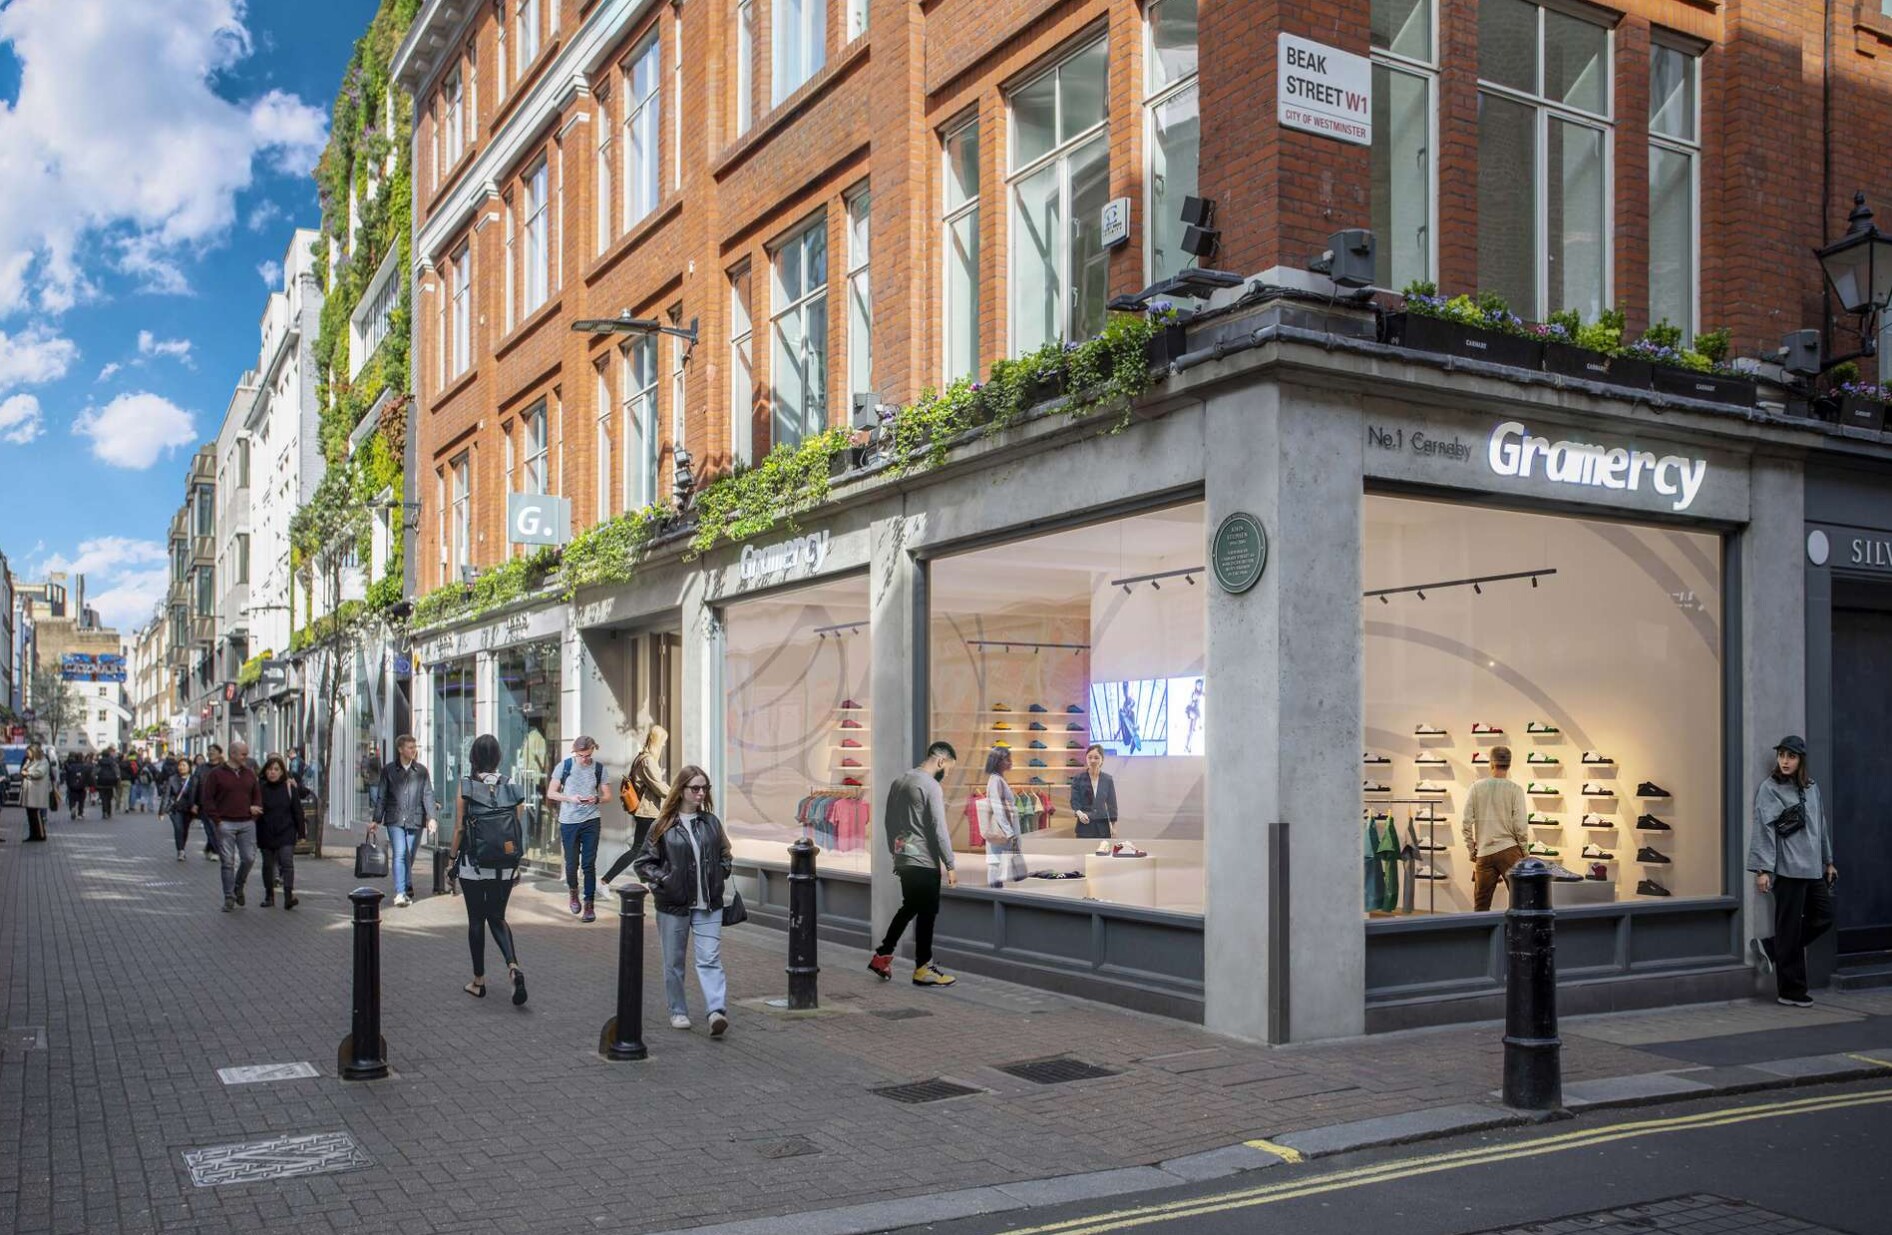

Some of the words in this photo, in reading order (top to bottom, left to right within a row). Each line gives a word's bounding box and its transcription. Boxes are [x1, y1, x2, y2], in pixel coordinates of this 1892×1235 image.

[1287, 46, 1327, 75] BEAK
[1286, 75, 1343, 107] STREET
[1346, 91, 1367, 114] W1
[1285, 109, 1301, 121] CITY
[1303, 113, 1312, 125] OF
[1313, 117, 1366, 138] WESTMINSTER
[1488, 421, 1706, 511] Gramercy
[517, 506, 553, 537] G.
[741, 529, 830, 580] Gramercy
